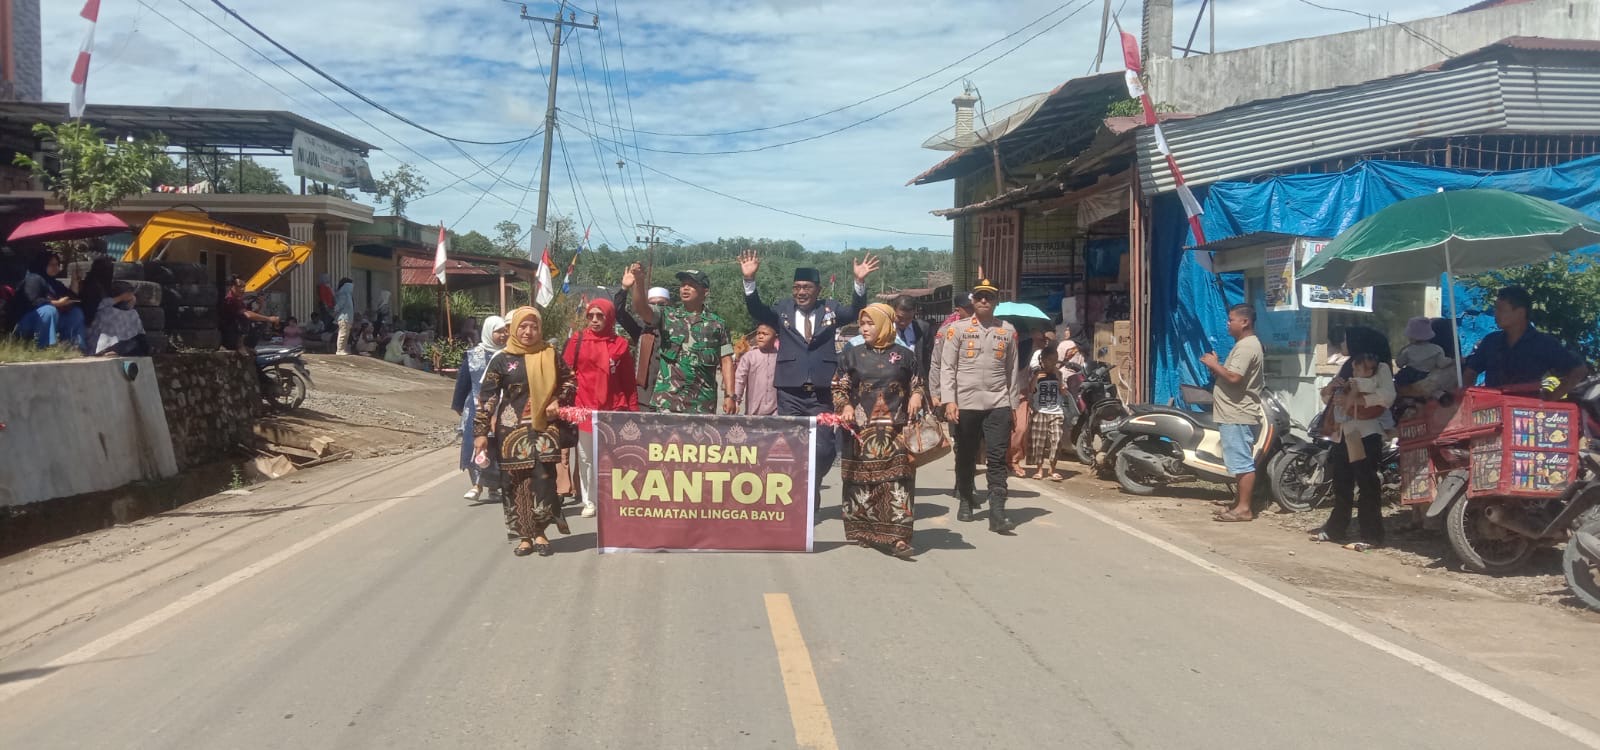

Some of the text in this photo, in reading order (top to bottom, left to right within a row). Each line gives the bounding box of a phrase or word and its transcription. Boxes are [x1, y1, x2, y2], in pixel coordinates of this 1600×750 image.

[211, 226, 257, 244] LIUGONG
[648, 443, 758, 465] BARISAN
[611, 468, 793, 506] KANTOR
[619, 506, 785, 522] KECAMATAN LINGGA BAYU
